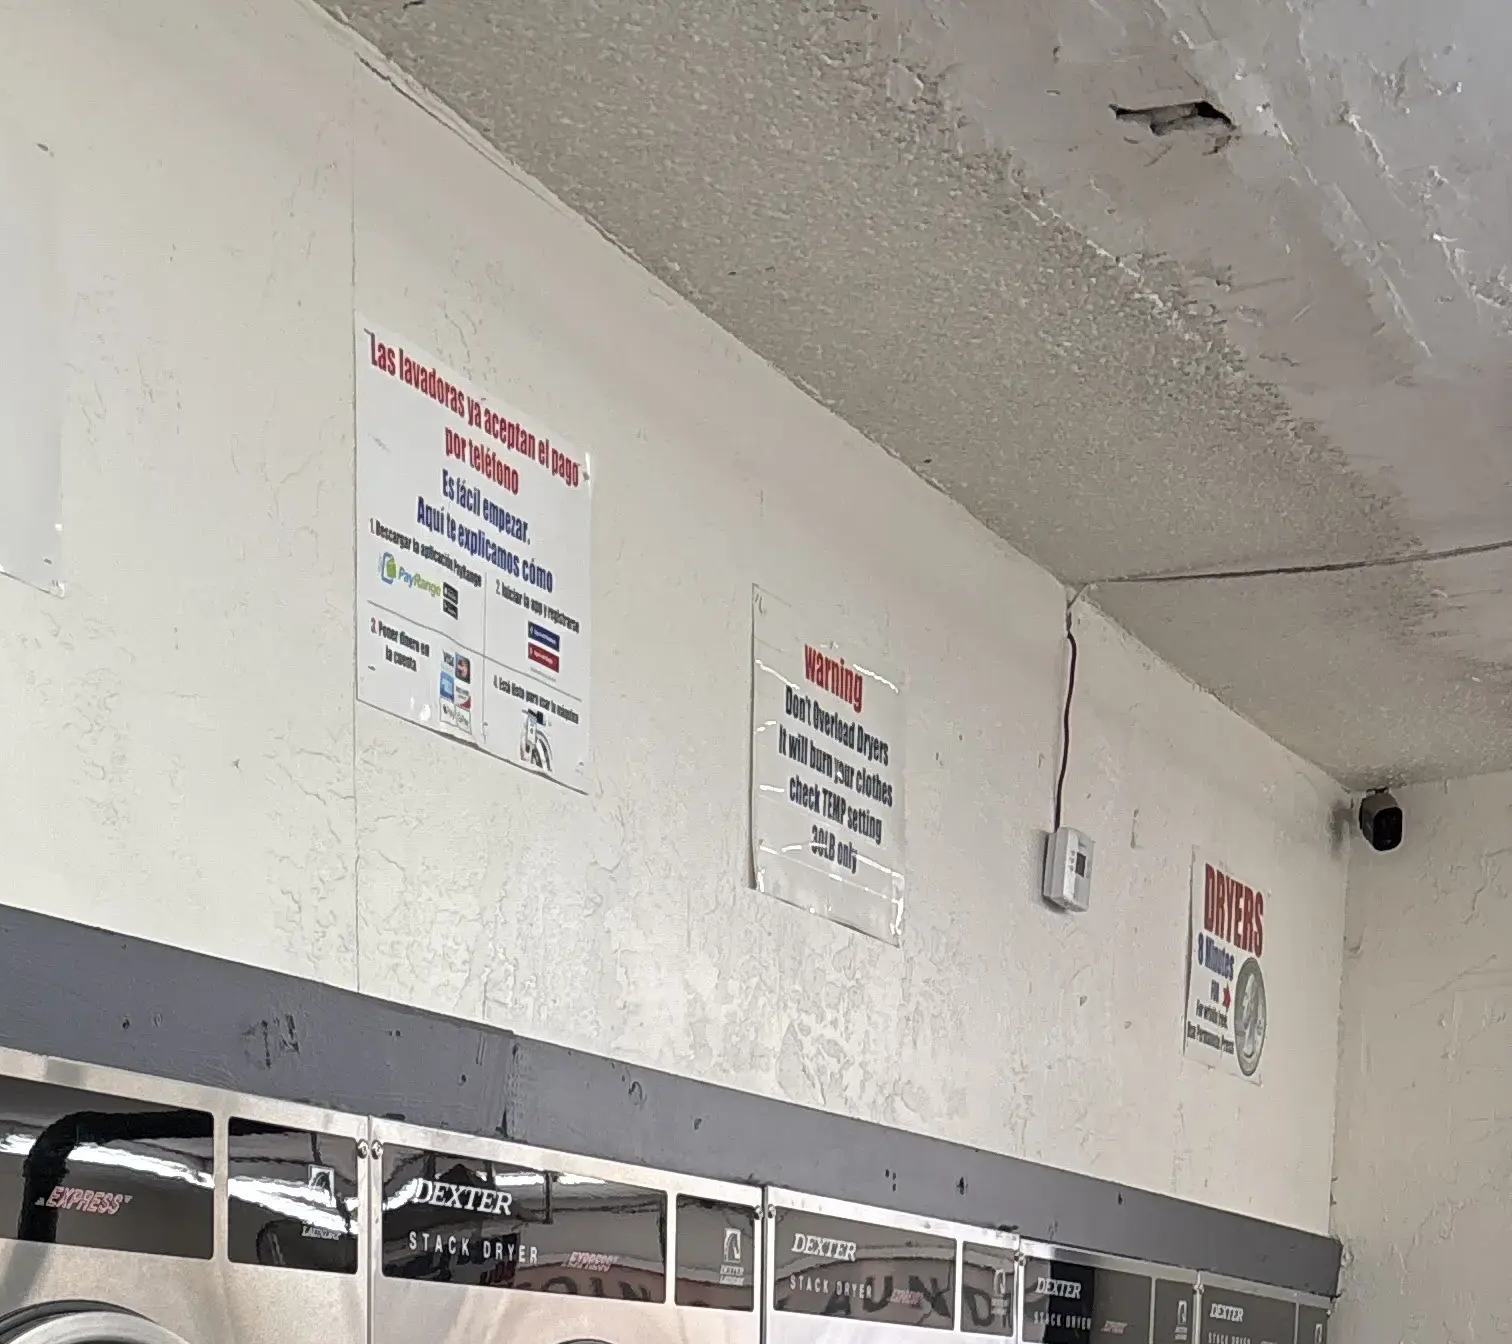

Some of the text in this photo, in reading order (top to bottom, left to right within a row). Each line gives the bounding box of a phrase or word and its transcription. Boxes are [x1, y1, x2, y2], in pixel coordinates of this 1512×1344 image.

[370, 332, 579, 487] Las lavadoras ya aceptan el pago
[445, 427, 519, 495] por teléfono
[442, 468, 454, 500] Es
[456, 477, 480, 517] fácil
[417, 496, 554, 593] Aquí te explicamos cómo
[804, 643, 863, 713] Warning
[786, 685, 889, 767] Don't Overload Dryers
[779, 724, 893, 808] It will burn your clothes
[789, 775, 882, 846] check TEMP setting
[837, 841, 857, 874] only
[1204, 862, 1264, 959] DRYERS
[1198, 932, 1204, 966] 8
[46, 1186, 125, 1215] EXPRESS
[414, 1179, 513, 1216] DEXTER
[409, 1230, 538, 1264] STACK DRYER
[791, 1232, 857, 1262] DEXTER
[790, 1275, 828, 1294] STACK
[837, 1281, 872, 1299] DRYER
[1035, 1277, 1081, 1299] DEXTER
[1209, 1303, 1244, 1322] DEXTER
